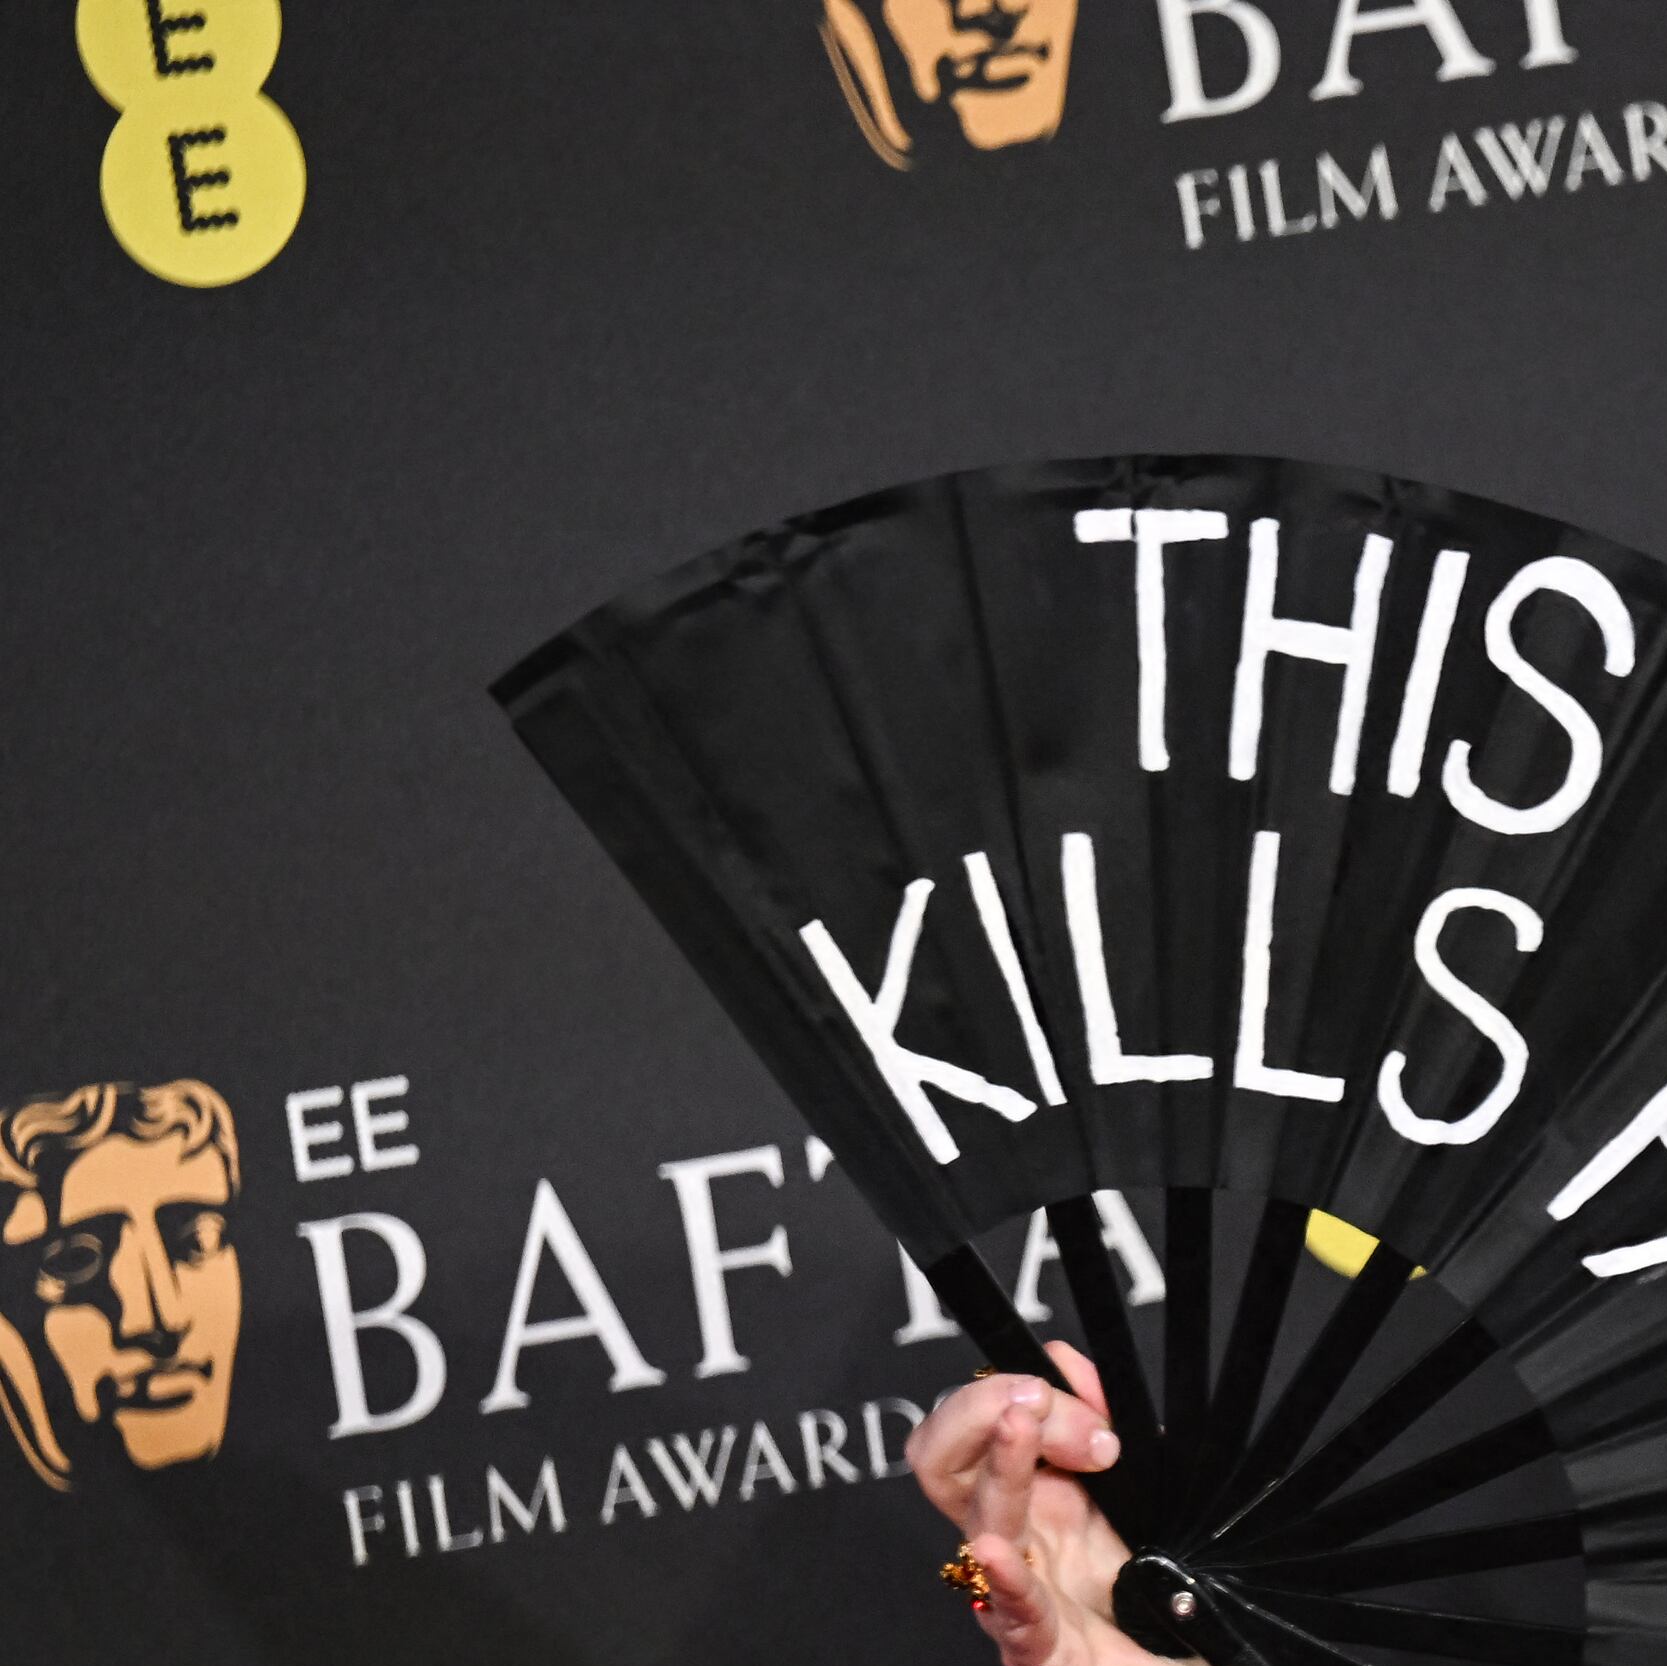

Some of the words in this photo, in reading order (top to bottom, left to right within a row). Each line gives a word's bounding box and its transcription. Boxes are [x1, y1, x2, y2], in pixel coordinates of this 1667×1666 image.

[1175, 145, 1399, 250] FILM
[1074, 508, 1635, 834] THIS
[800, 831, 1543, 1176] KILLS
[285, 1075, 419, 1182] EE
[343, 1458, 567, 1565] FILM
[601, 1399, 931, 1524] AWARD
